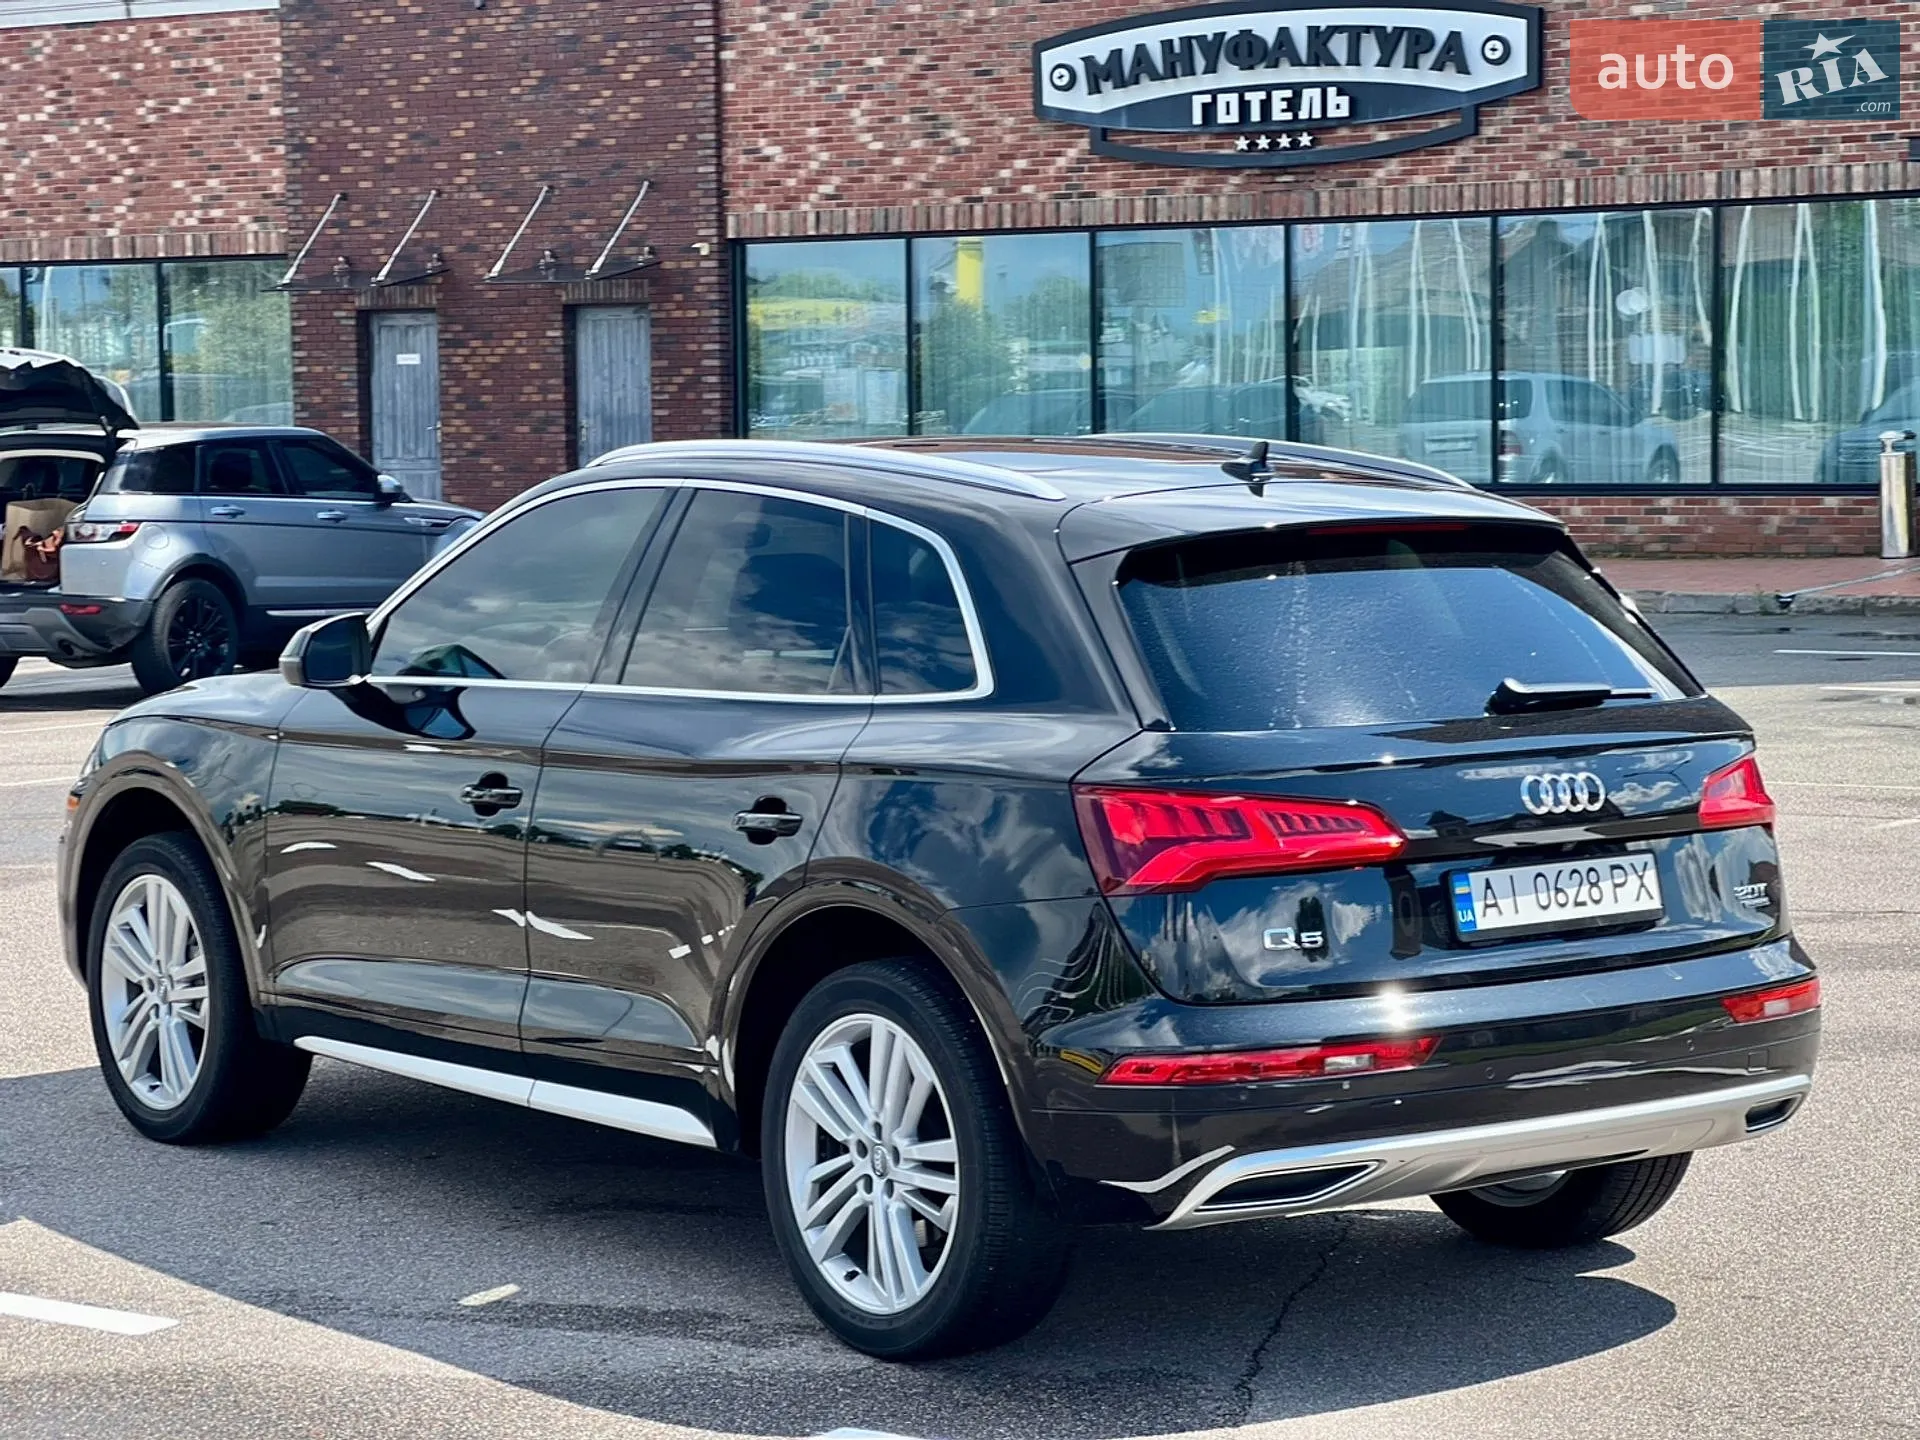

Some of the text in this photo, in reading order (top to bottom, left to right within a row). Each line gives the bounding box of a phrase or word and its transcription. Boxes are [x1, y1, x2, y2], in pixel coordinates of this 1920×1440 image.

[1079, 25, 1472, 96] МАНУФАКТУРА
[1191, 87, 1351, 126] ГОТЕЛЬ
[1532, 866, 1604, 912] 0628
[1609, 861, 1655, 904] PX
[1458, 909, 1475, 924] UA
[1263, 926, 1324, 951] Q5
